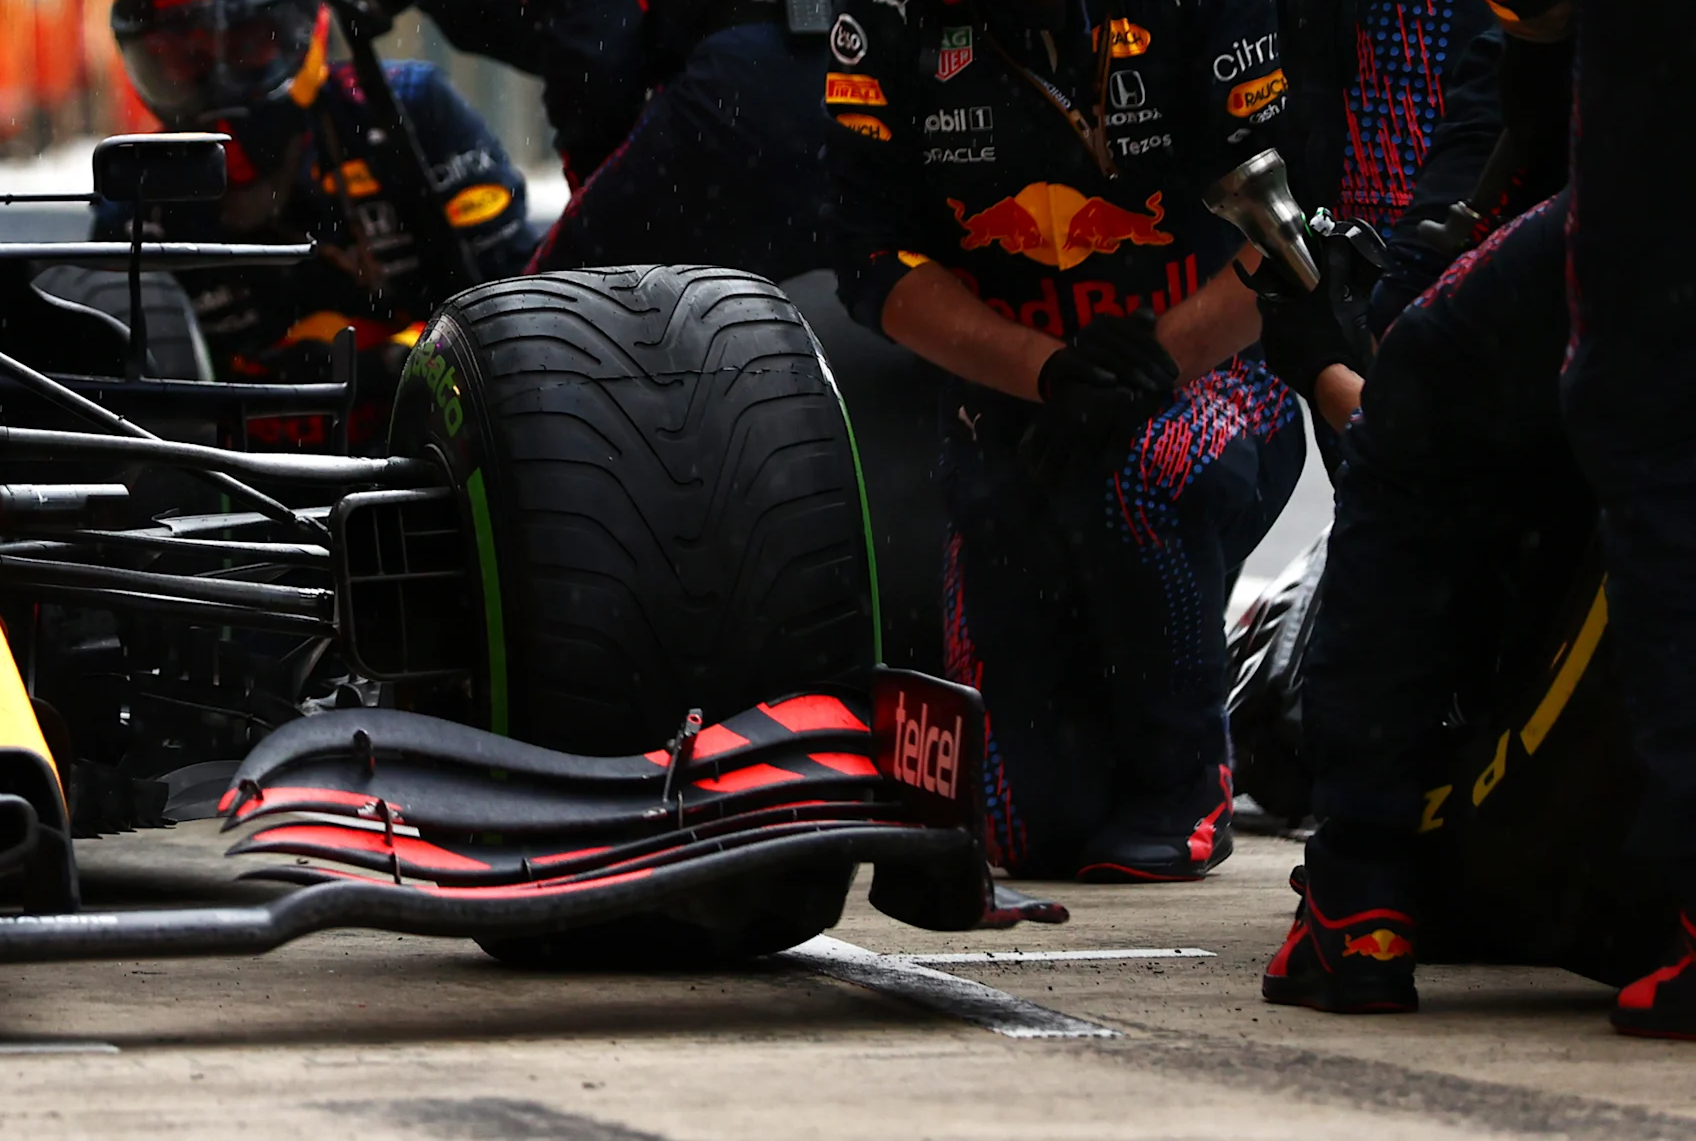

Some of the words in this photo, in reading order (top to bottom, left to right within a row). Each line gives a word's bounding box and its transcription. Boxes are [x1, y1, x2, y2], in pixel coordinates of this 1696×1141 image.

[1213, 31, 1280, 83] citri
[924, 108, 967, 133] obil
[1116, 133, 1172, 157] Tezos
[894, 690, 964, 801] telcel
